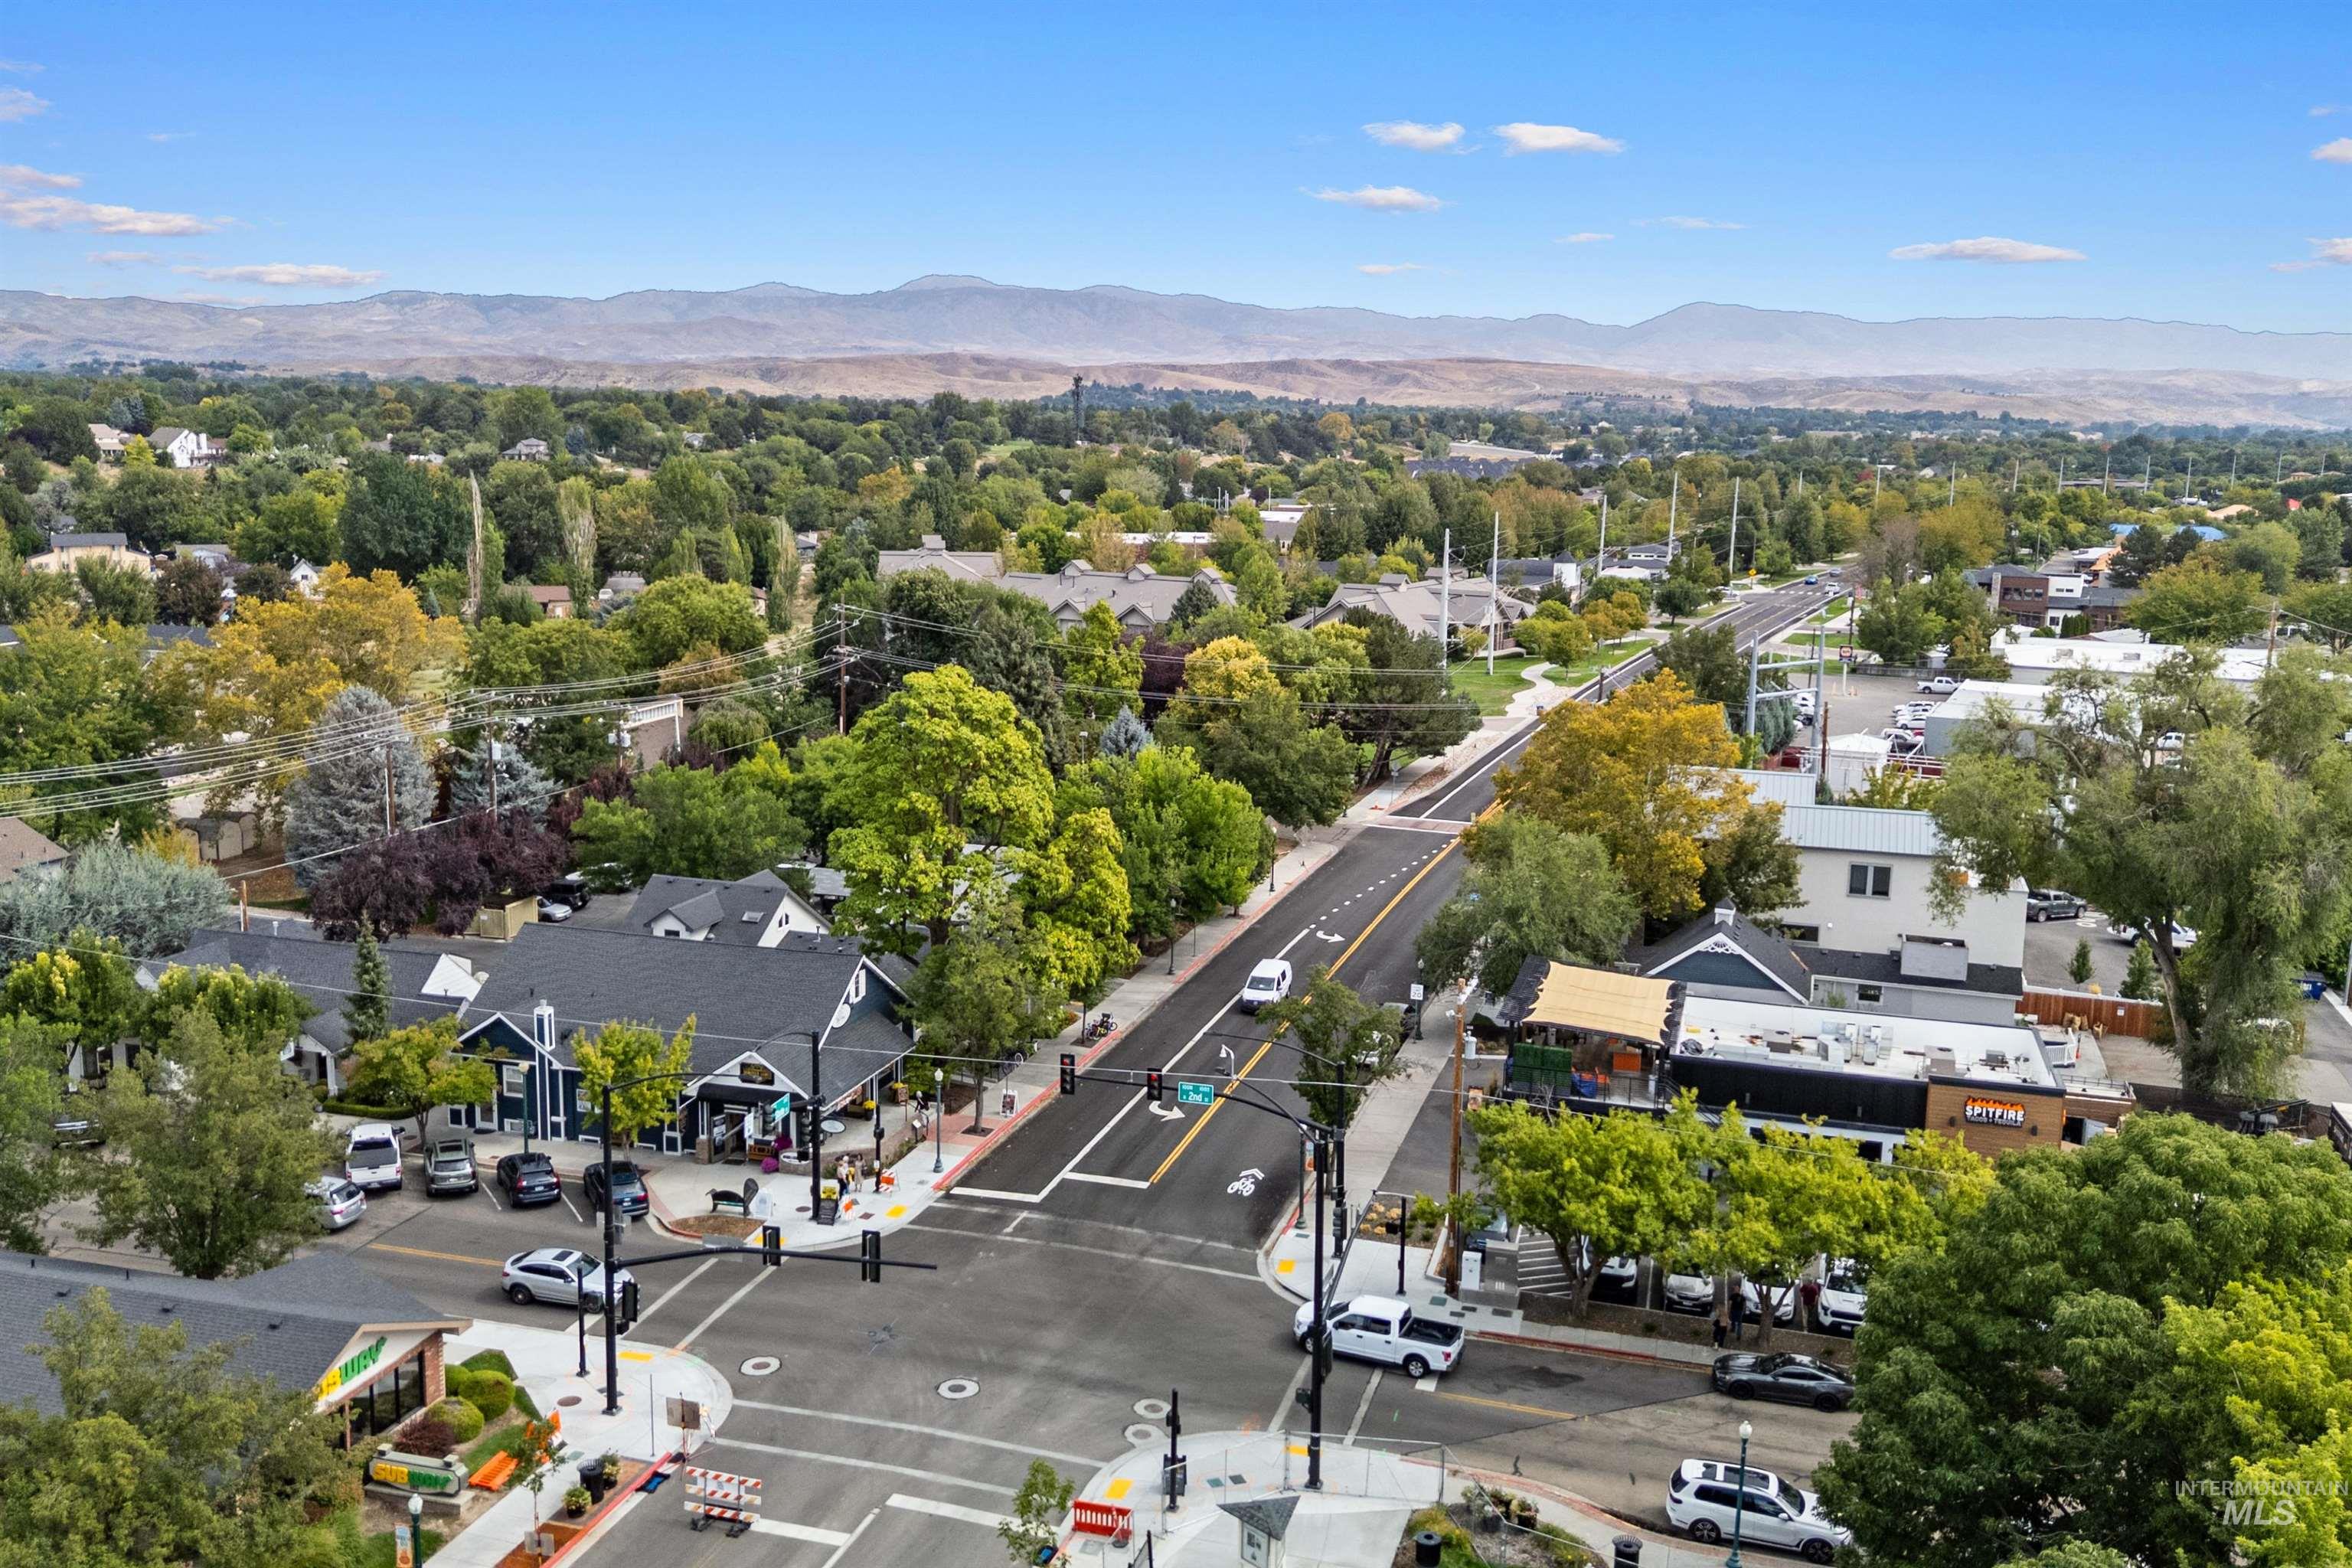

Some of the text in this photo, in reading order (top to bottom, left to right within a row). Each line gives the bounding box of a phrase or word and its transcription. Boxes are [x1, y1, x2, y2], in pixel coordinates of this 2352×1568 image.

[1188, 1092, 1202, 1101] 2nd
[1965, 1105, 2024, 1122] SPITFIRE
[1994, 1118, 2021, 1126] TEQUILA
[373, 1463, 453, 1489] SUBWAY
